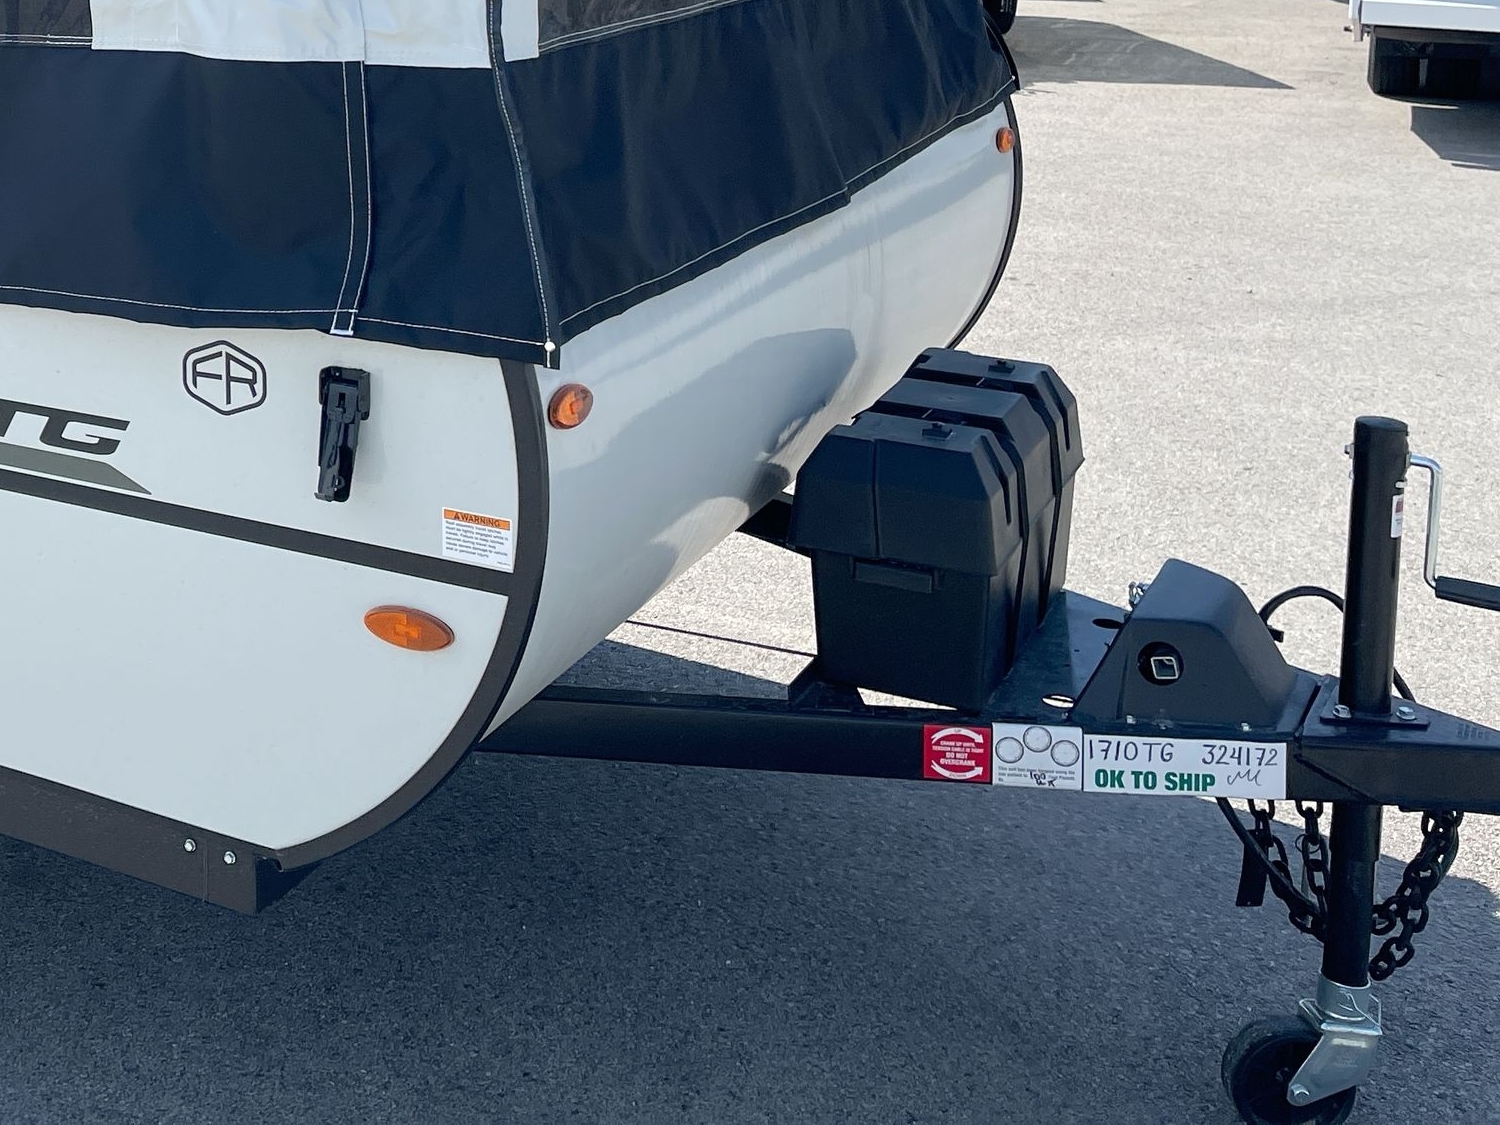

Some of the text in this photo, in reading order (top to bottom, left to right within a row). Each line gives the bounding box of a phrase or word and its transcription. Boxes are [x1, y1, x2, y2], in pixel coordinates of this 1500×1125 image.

[192, 350, 258, 406] FR
[460, 513, 500, 528] WARNING
[1202, 744, 1278, 767] 324172
[1094, 769, 1125, 789] OK
[1131, 771, 1157, 790] TO
[1165, 773, 1216, 792] SHIP
